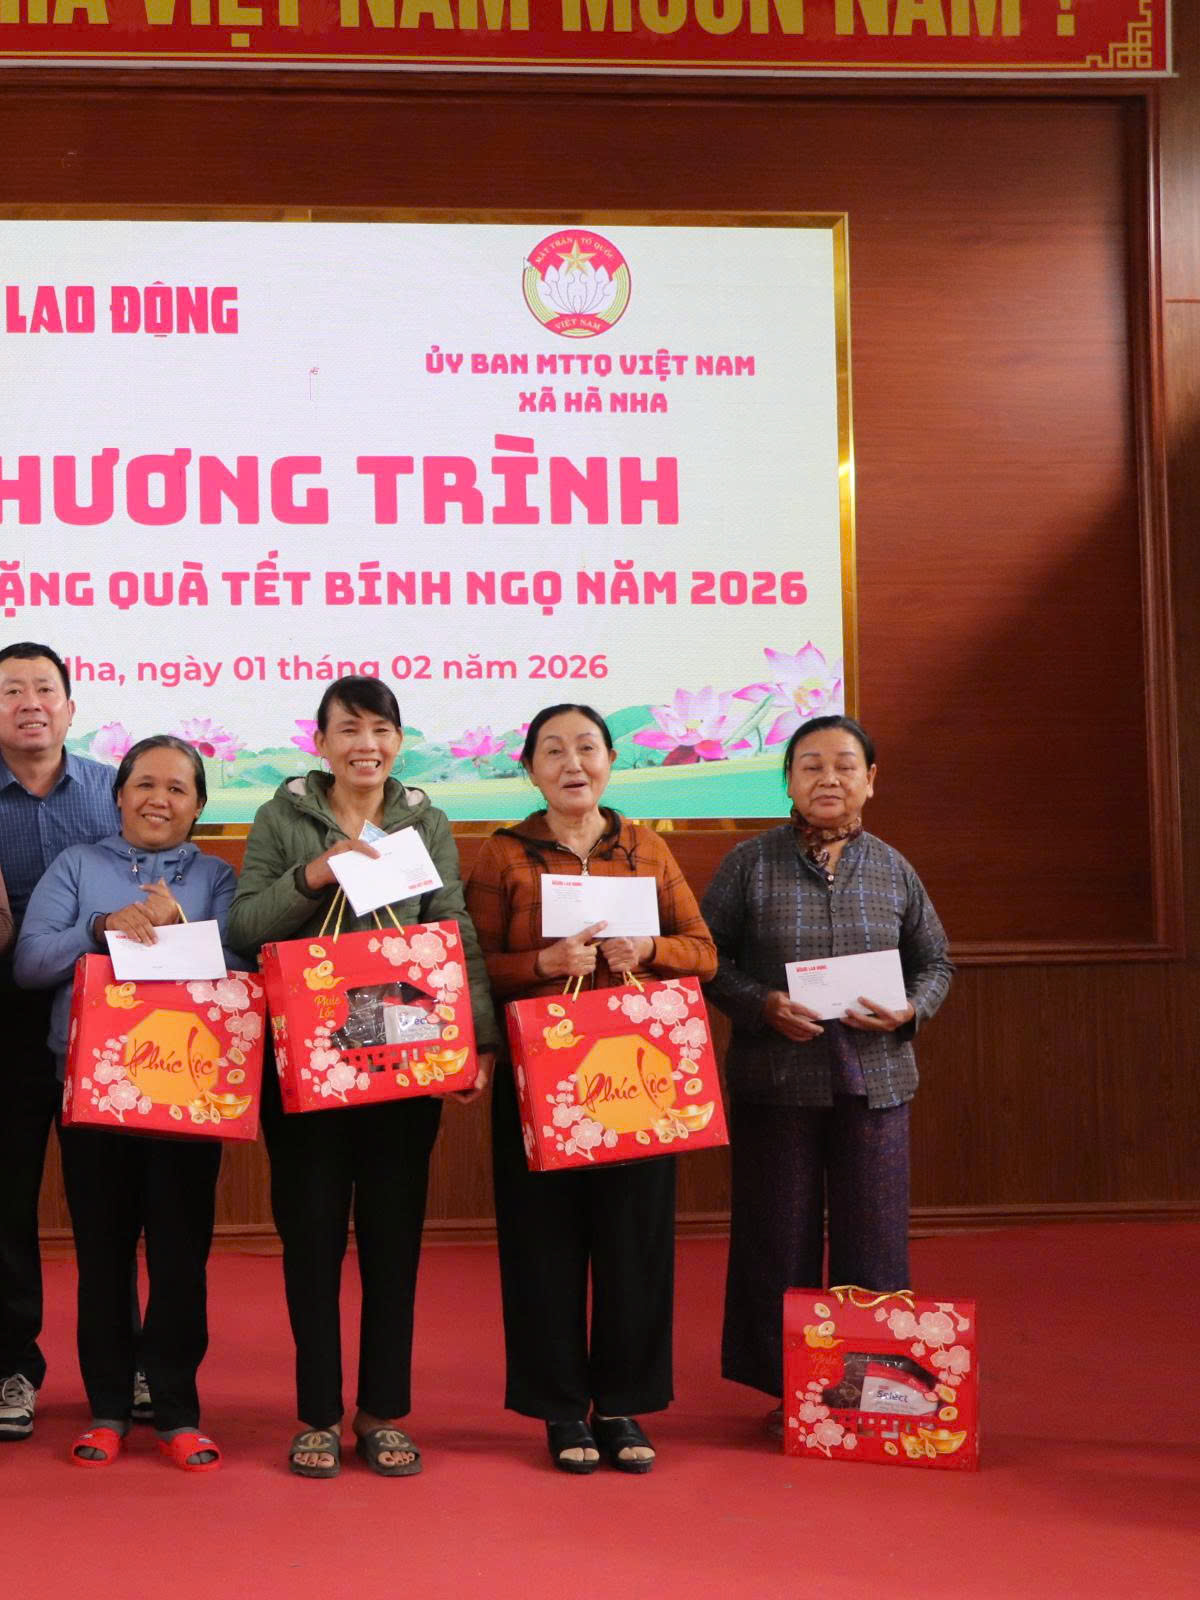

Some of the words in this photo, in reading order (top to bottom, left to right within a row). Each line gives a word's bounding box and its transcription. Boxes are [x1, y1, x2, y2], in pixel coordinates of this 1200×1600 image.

[5, 285, 96, 334] LAO
[109, 280, 239, 338] ĐỘNG
[425, 345, 464, 374] ỦY
[471, 353, 529, 375] BAN
[536, 353, 613, 377] MTTQ
[619, 348, 689, 382] VIỆT
[695, 355, 756, 377] NAM
[518, 386, 557, 413] XÃ
[564, 386, 603, 414] HÀ
[610, 393, 669, 414] NHA
[355, 433, 680, 526] TRÌNH
[108, 560, 209, 610] QUÀ
[221, 549, 312, 607] TẾT
[324, 560, 452, 606] BÍNH
[466, 571, 563, 617] NGỌ
[576, 559, 678, 606] NĂM
[690, 571, 809, 606] 2026
[64, 656, 127, 686] ha,
[137, 655, 223, 688] ngày
[233, 656, 266, 681] 01
[391, 655, 433, 680] 02
[443, 654, 518, 680] năm
[528, 654, 609, 680] 2026
